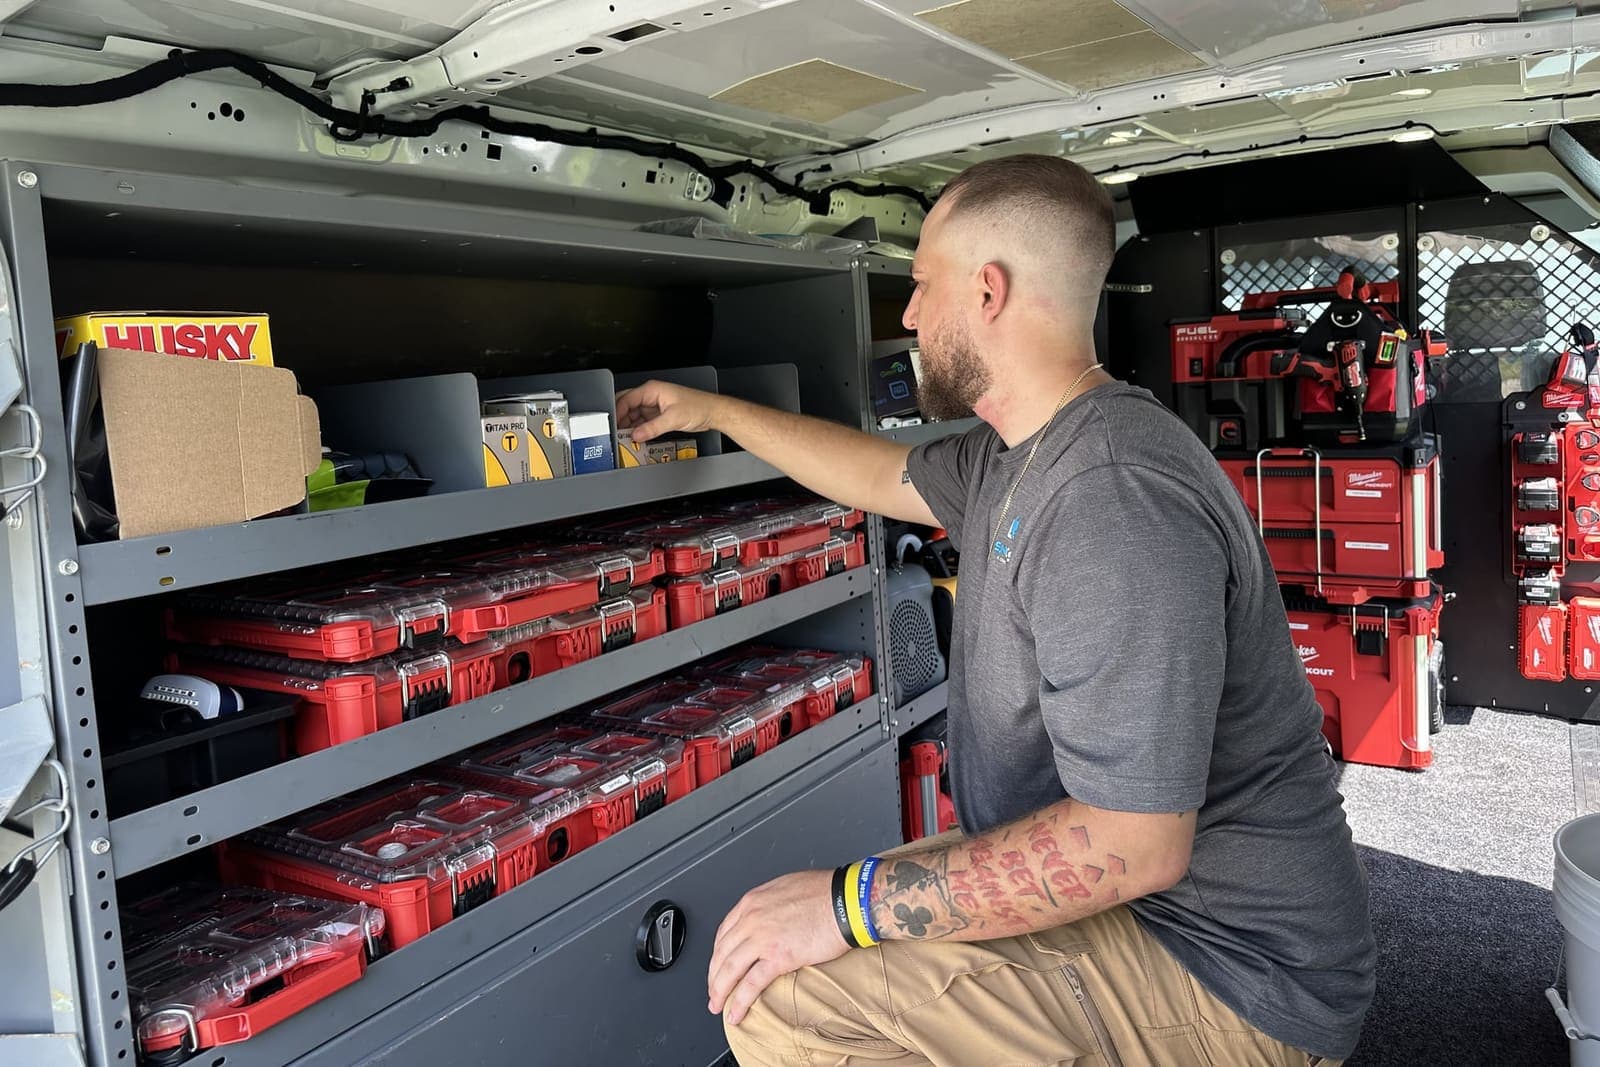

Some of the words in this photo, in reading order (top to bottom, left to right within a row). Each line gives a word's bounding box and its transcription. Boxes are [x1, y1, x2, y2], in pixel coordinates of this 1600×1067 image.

[1176, 326, 1217, 335] FUEL
[103, 324, 257, 360] HUSKY
[485, 423, 509, 433] TITAN
[510, 422, 525, 431] PRO
[1305, 667, 1335, 676] KOUT
[860, 861, 874, 882] TRUMP
